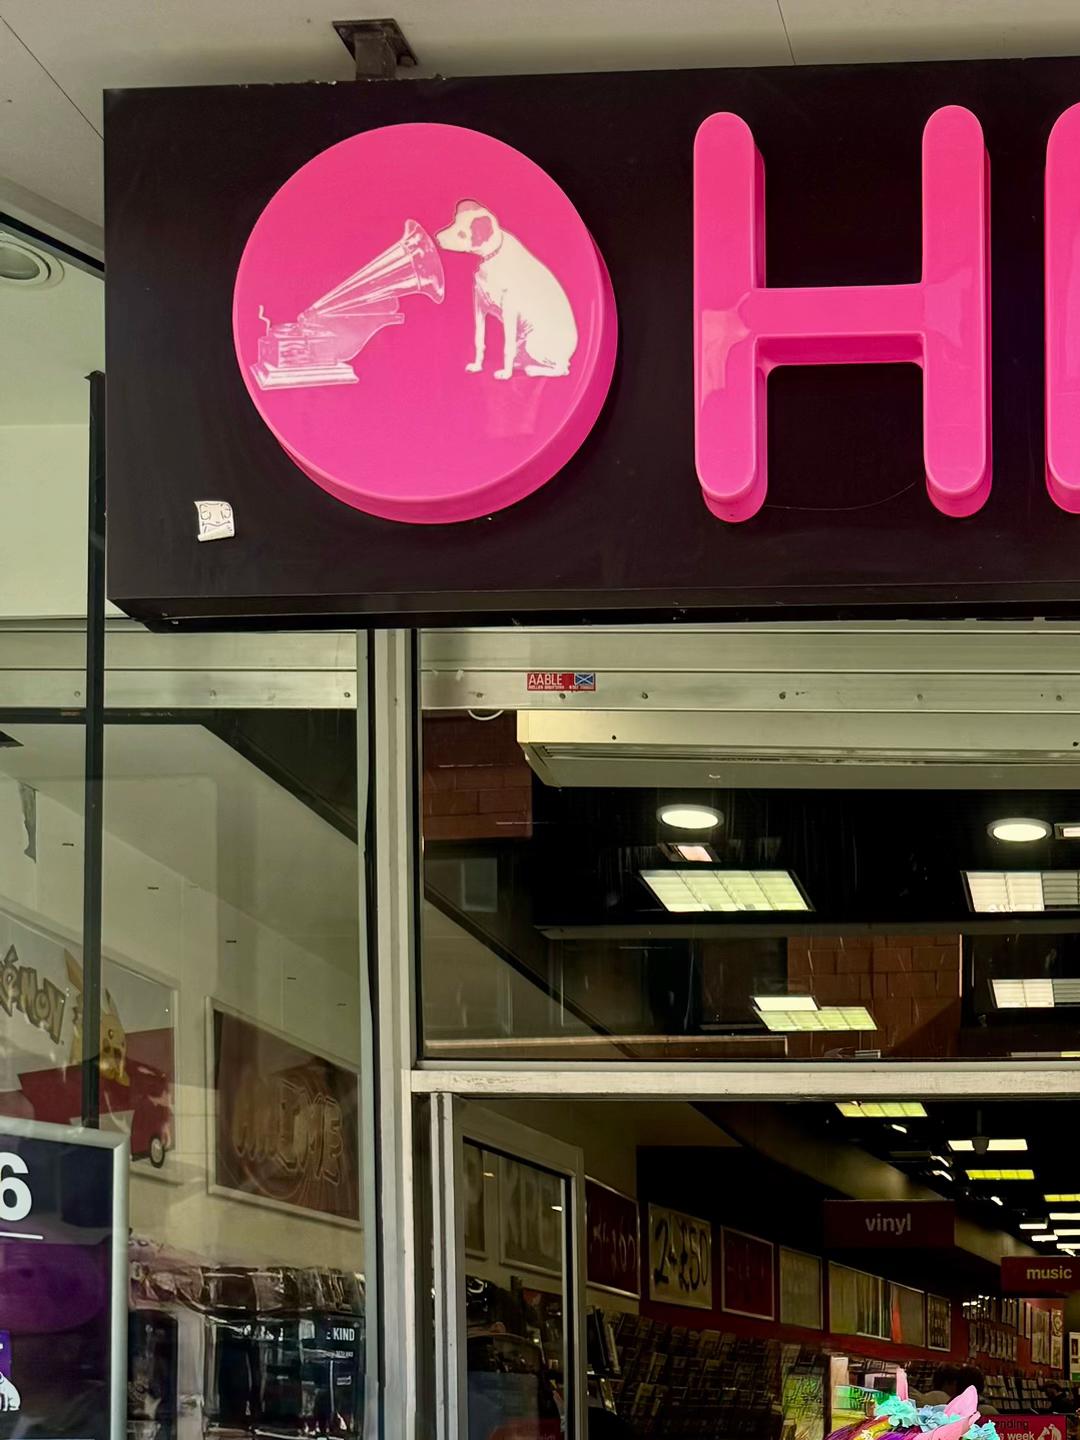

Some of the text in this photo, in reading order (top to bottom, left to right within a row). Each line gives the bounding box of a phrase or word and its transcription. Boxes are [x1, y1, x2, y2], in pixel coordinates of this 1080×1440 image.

[528, 674, 562, 685] AABLE
[865, 1212, 912, 1237] vinyl
[1026, 1266, 1072, 1280] music
[1000, 1419, 1028, 1431] nding
[1008, 1431, 1034, 1440] week
